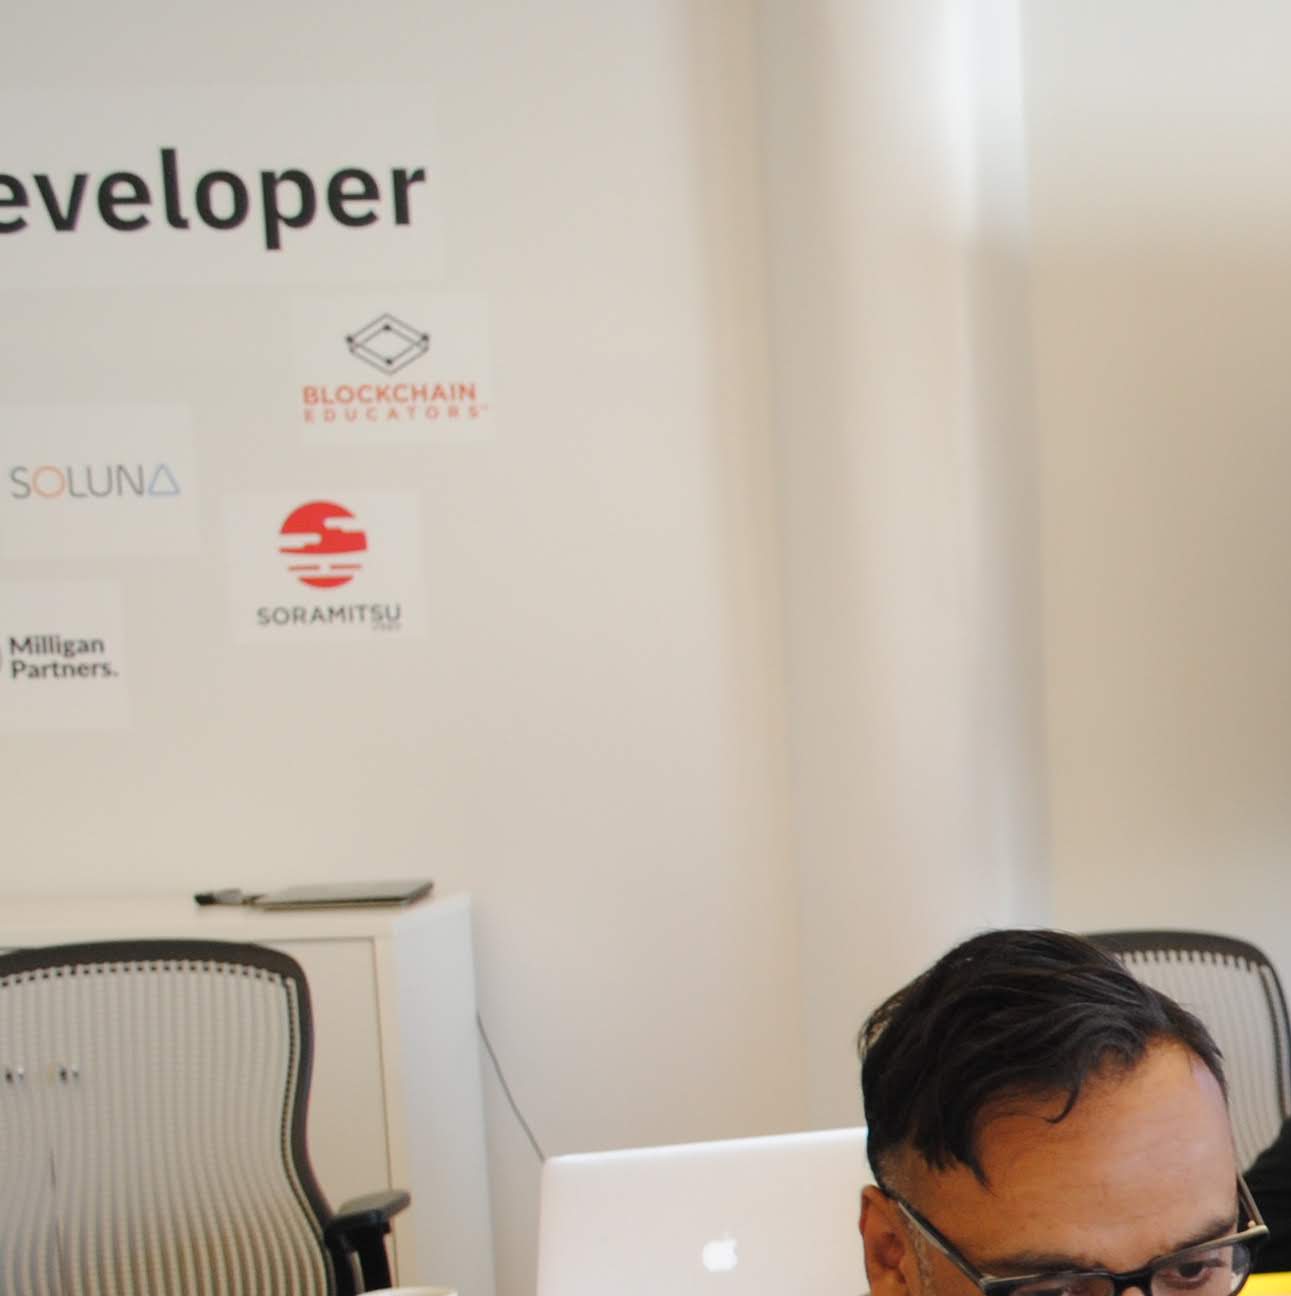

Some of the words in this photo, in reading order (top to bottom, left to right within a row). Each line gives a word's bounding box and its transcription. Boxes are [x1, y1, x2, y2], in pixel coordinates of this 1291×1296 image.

[0, 148, 426, 250] eveloper
[303, 384, 478, 405] BLOCKCHAIN
[304, 406, 480, 424] EDUCATORS
[257, 603, 402, 627] SORAMITSU
[9, 634, 105, 659] Milligan
[11, 658, 119, 679] Partners.
